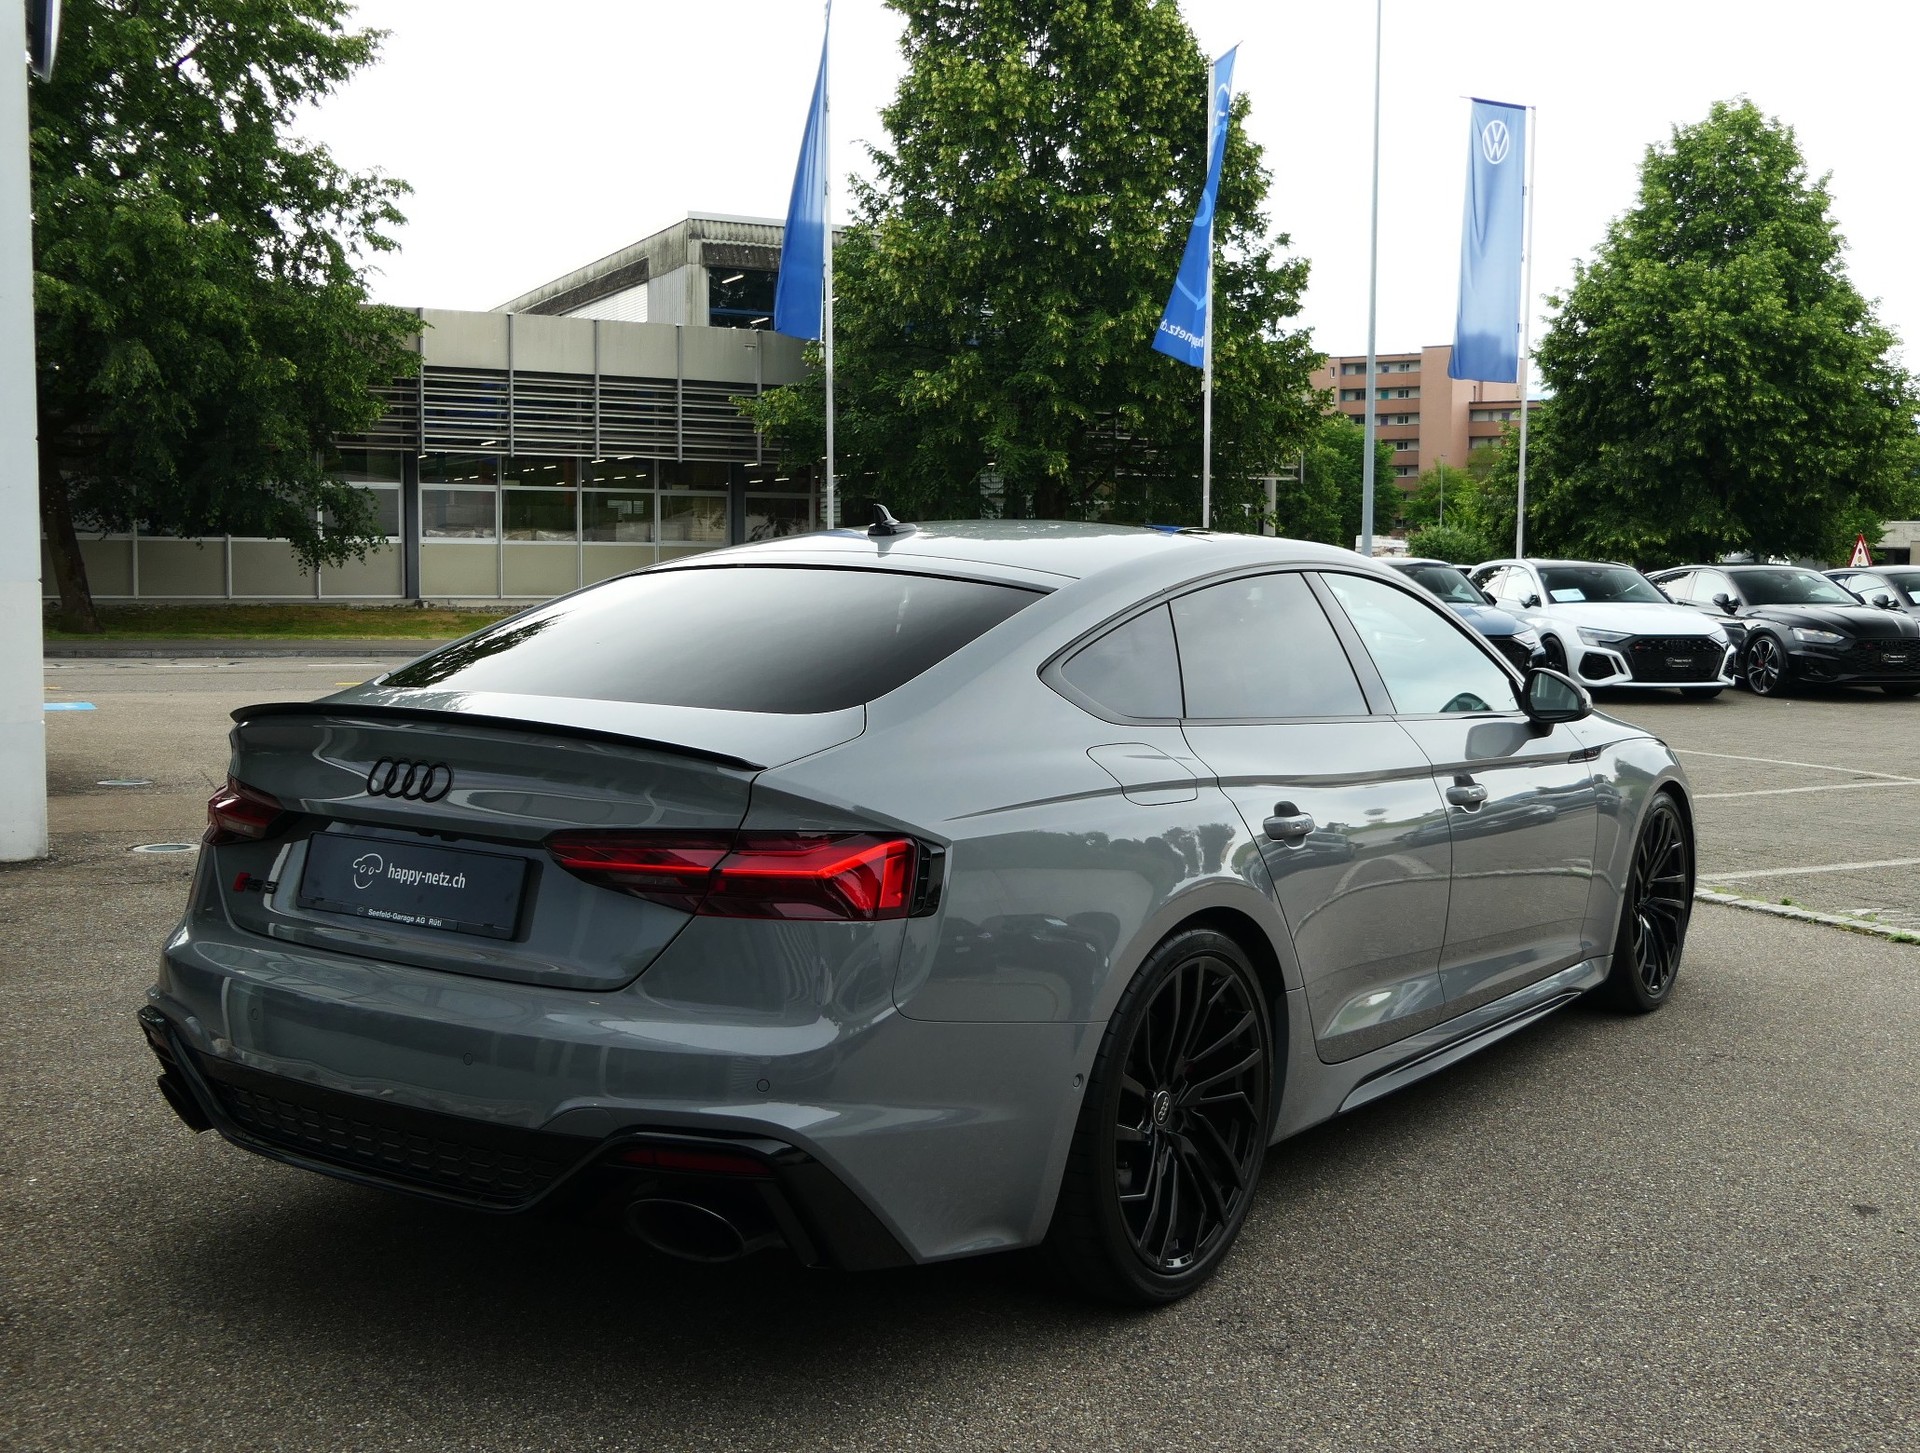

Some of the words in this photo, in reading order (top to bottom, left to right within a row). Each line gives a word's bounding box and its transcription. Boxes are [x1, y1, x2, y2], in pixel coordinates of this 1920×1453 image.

[1483, 120, 1509, 164] VW
[387, 862, 466, 889] happy-netz.ch
[368, 908, 415, 923] Seefeld-Garage
[415, 916, 426, 924] AG
[428, 918, 442, 927] Rüti
